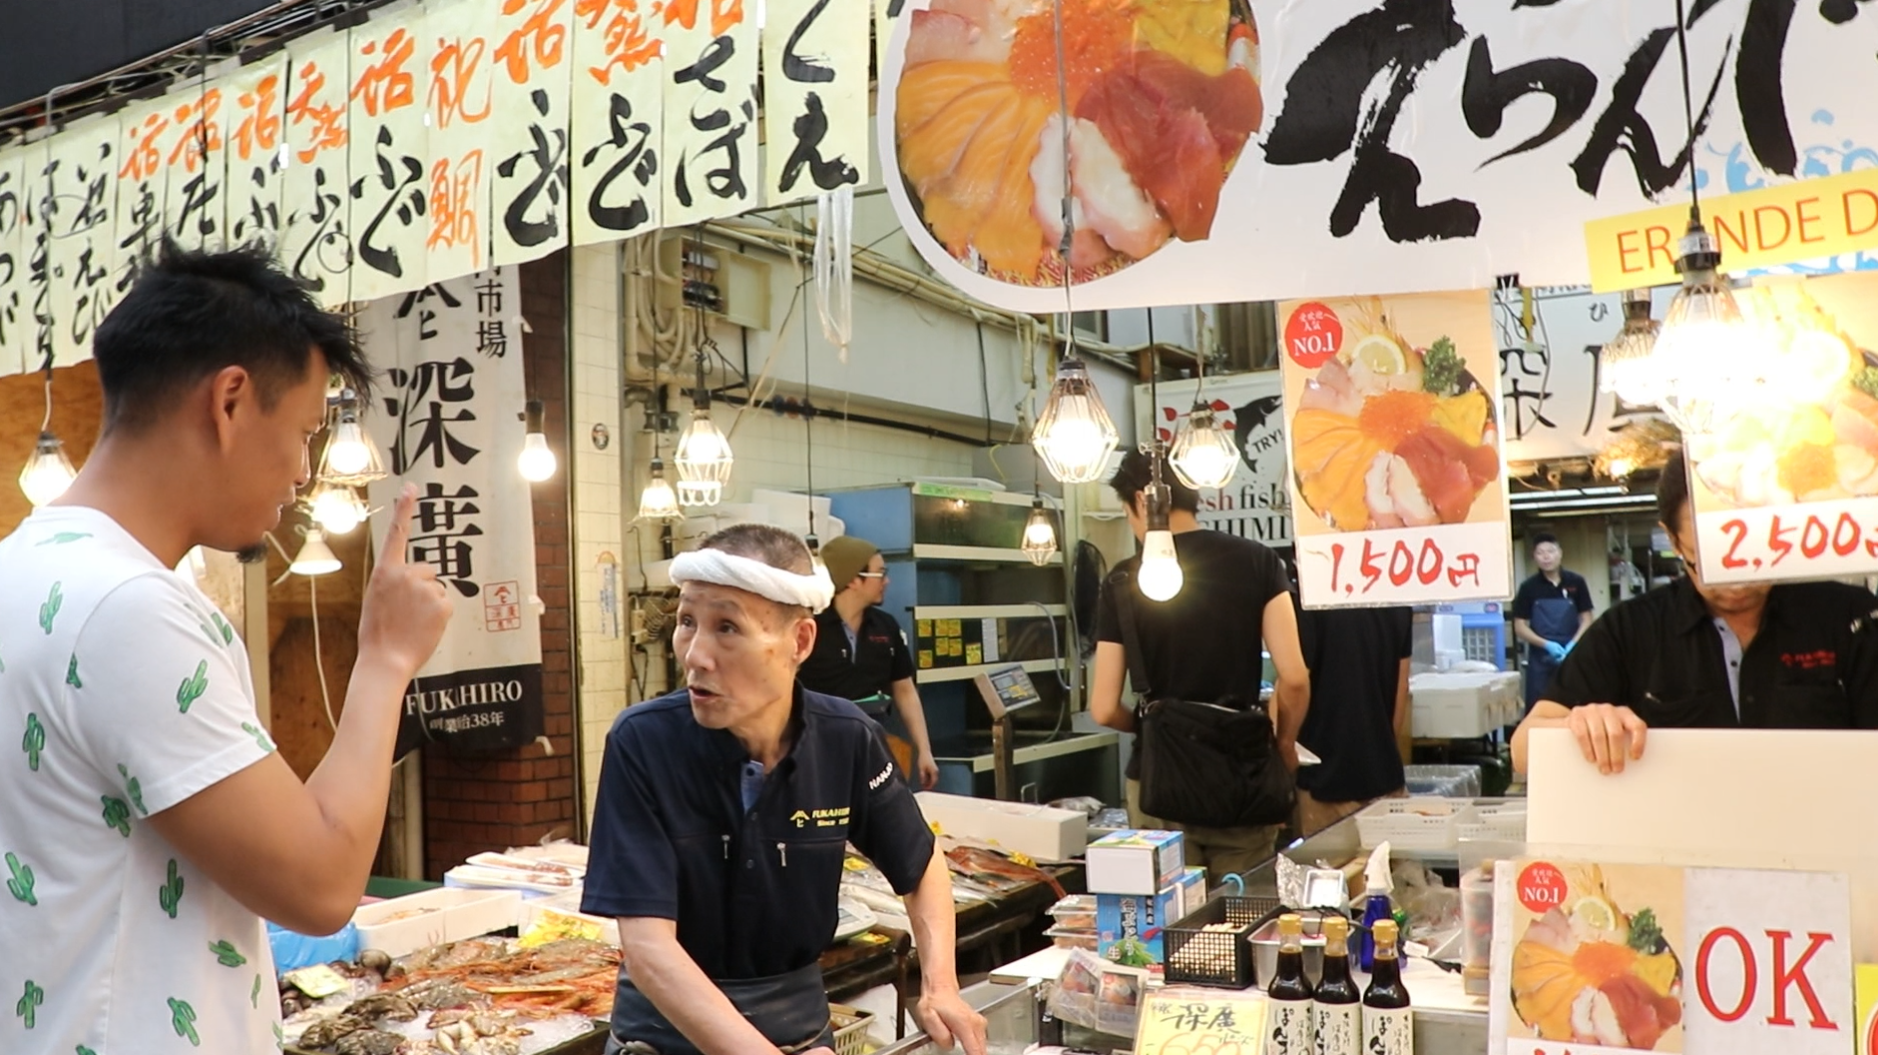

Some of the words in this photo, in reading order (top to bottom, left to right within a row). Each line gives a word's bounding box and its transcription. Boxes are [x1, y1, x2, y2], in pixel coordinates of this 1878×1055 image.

[1616, 196, 1826, 275] ERNDE
[474, 264, 508, 359] 市場
[1252, 428, 1285, 455] TRY!
[1695, 925, 1840, 1031] OK
